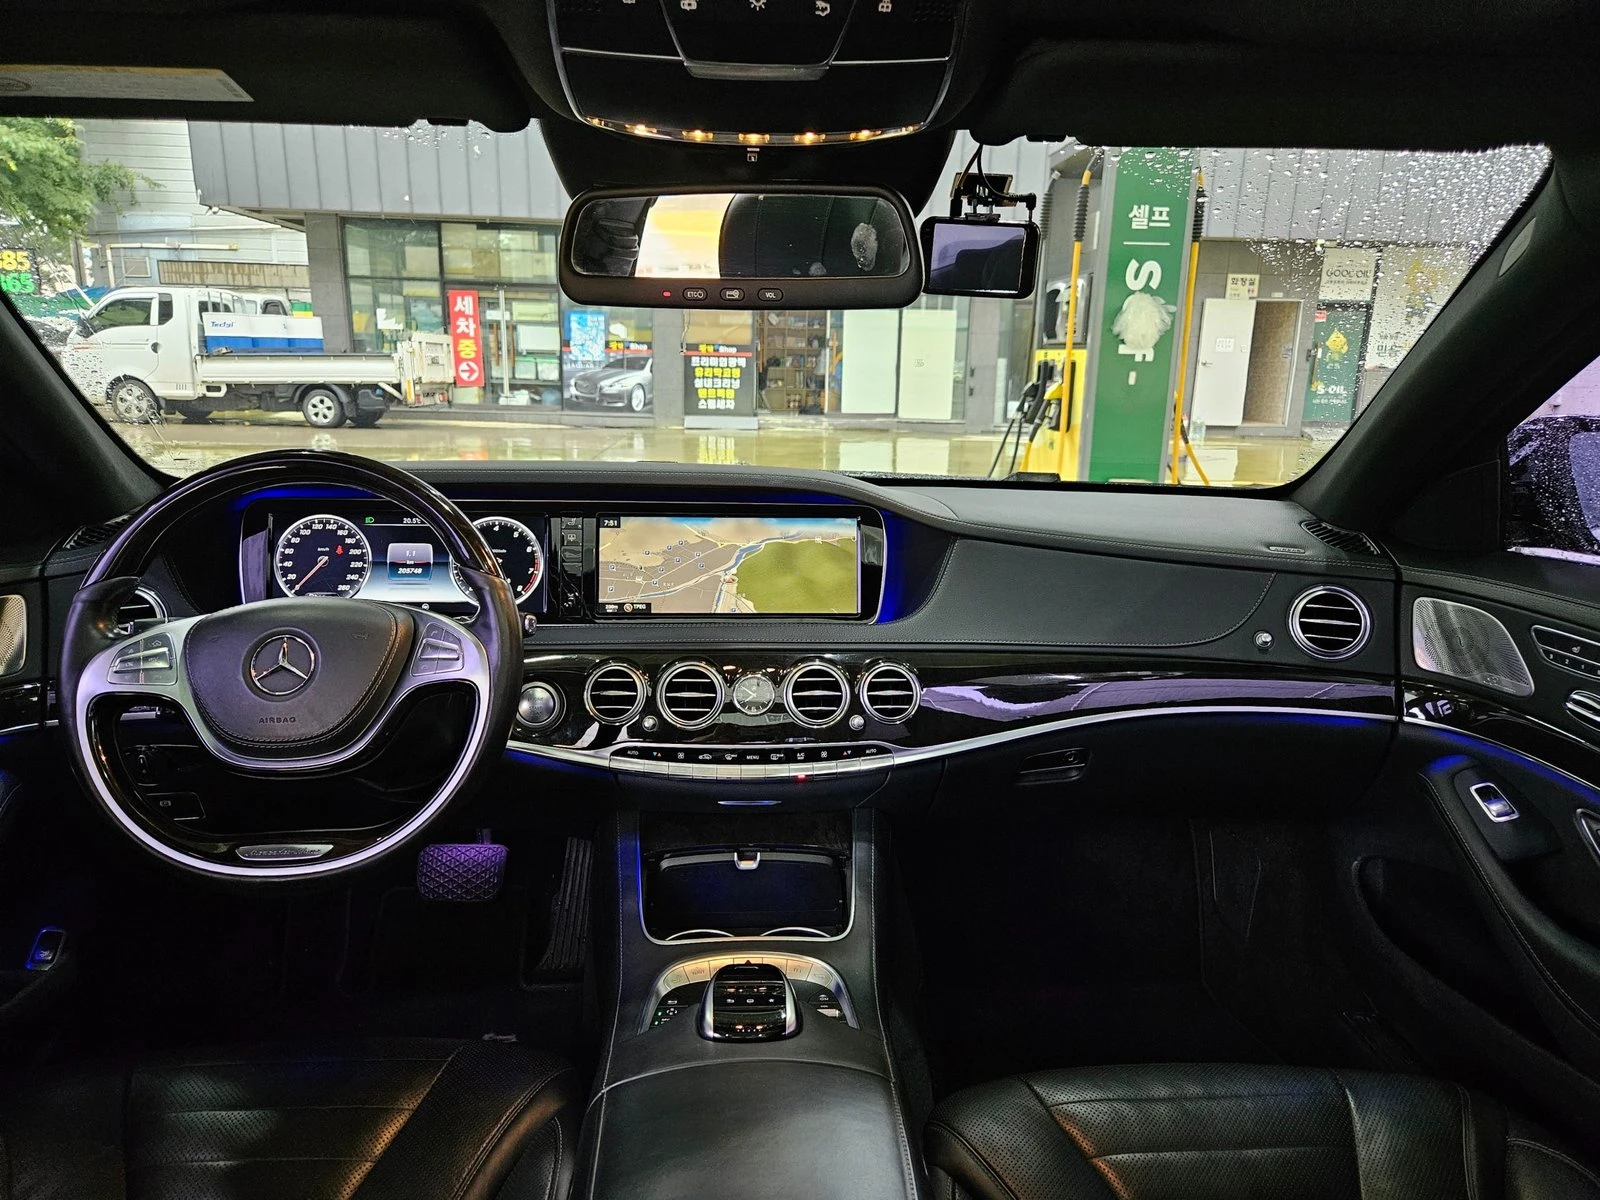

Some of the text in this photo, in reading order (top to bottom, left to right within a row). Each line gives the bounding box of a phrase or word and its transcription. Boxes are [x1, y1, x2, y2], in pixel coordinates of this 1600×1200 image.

[1128, 204, 1171, 230] 셀프
[0, 250, 31, 271] 85
[1231, 277, 1256, 286] 화장실
[1117, 258, 1163, 362] SF
[454, 295, 478, 359] 세차중
[694, 367, 741, 378] 유리막코팅
[1316, 385, 1348, 395] S-OIL
[698, 399, 735, 409] 스팀세차
[258, 716, 296, 724] AIRBAG
